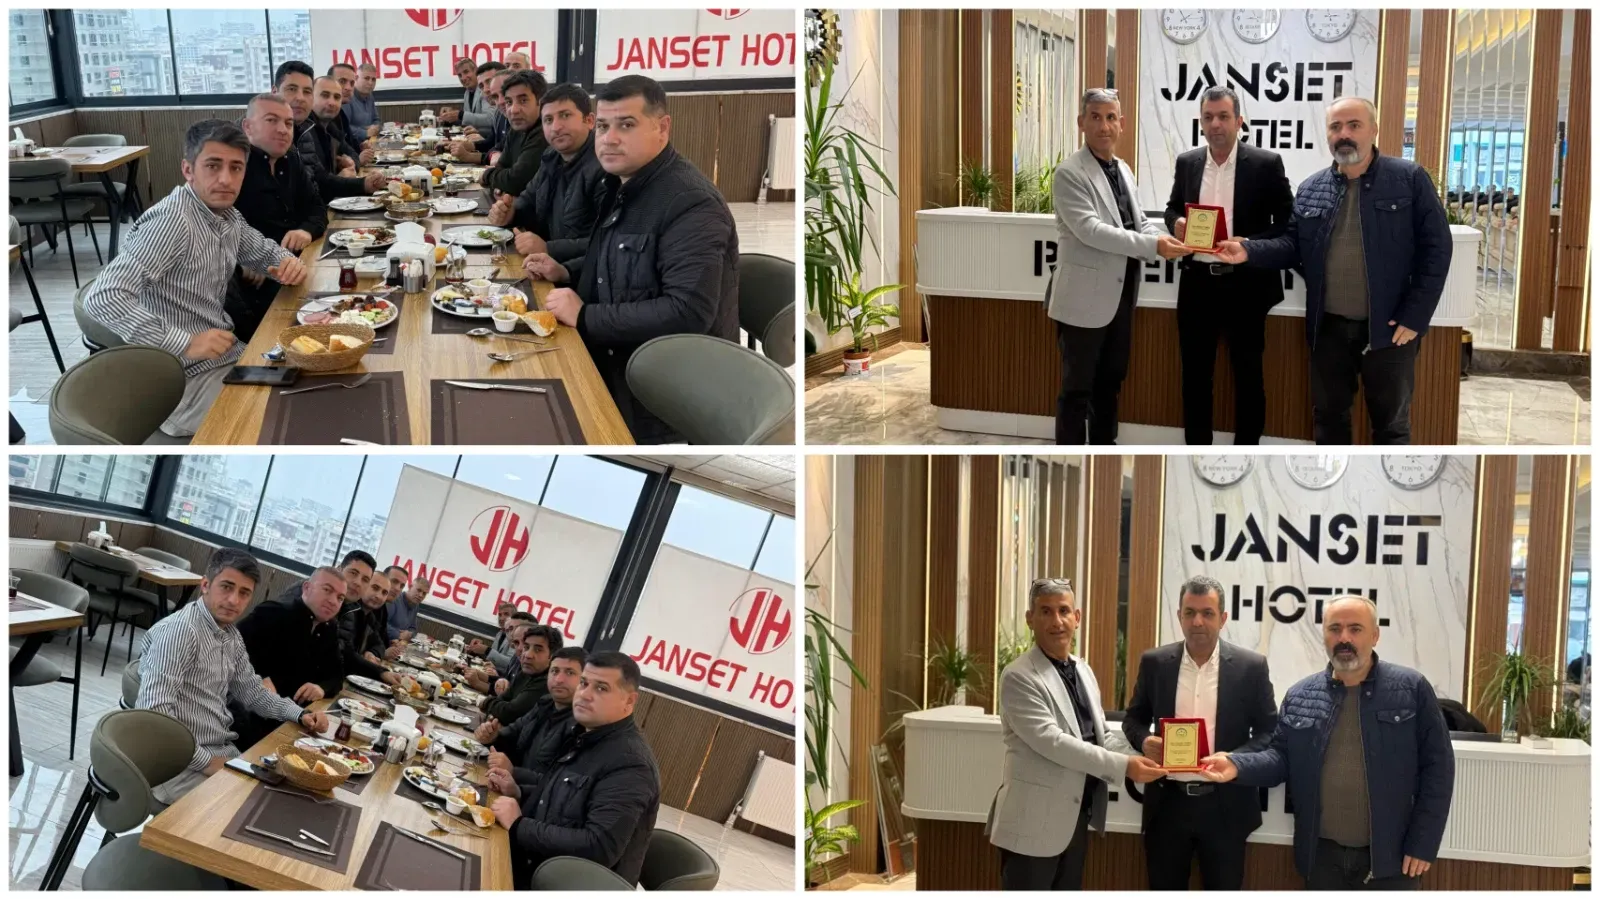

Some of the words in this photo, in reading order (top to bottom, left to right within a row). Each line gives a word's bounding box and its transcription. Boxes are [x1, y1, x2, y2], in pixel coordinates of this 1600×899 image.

[606, 35, 731, 70] JANSET
[1160, 61, 1353, 102] JANSET
[1191, 118, 1314, 149] TEL
[1191, 513, 1442, 566] JANSET
[1231, 584, 1390, 627] HOTL
[630, 635, 748, 693] JANSET
[749, 671, 796, 714] HO
